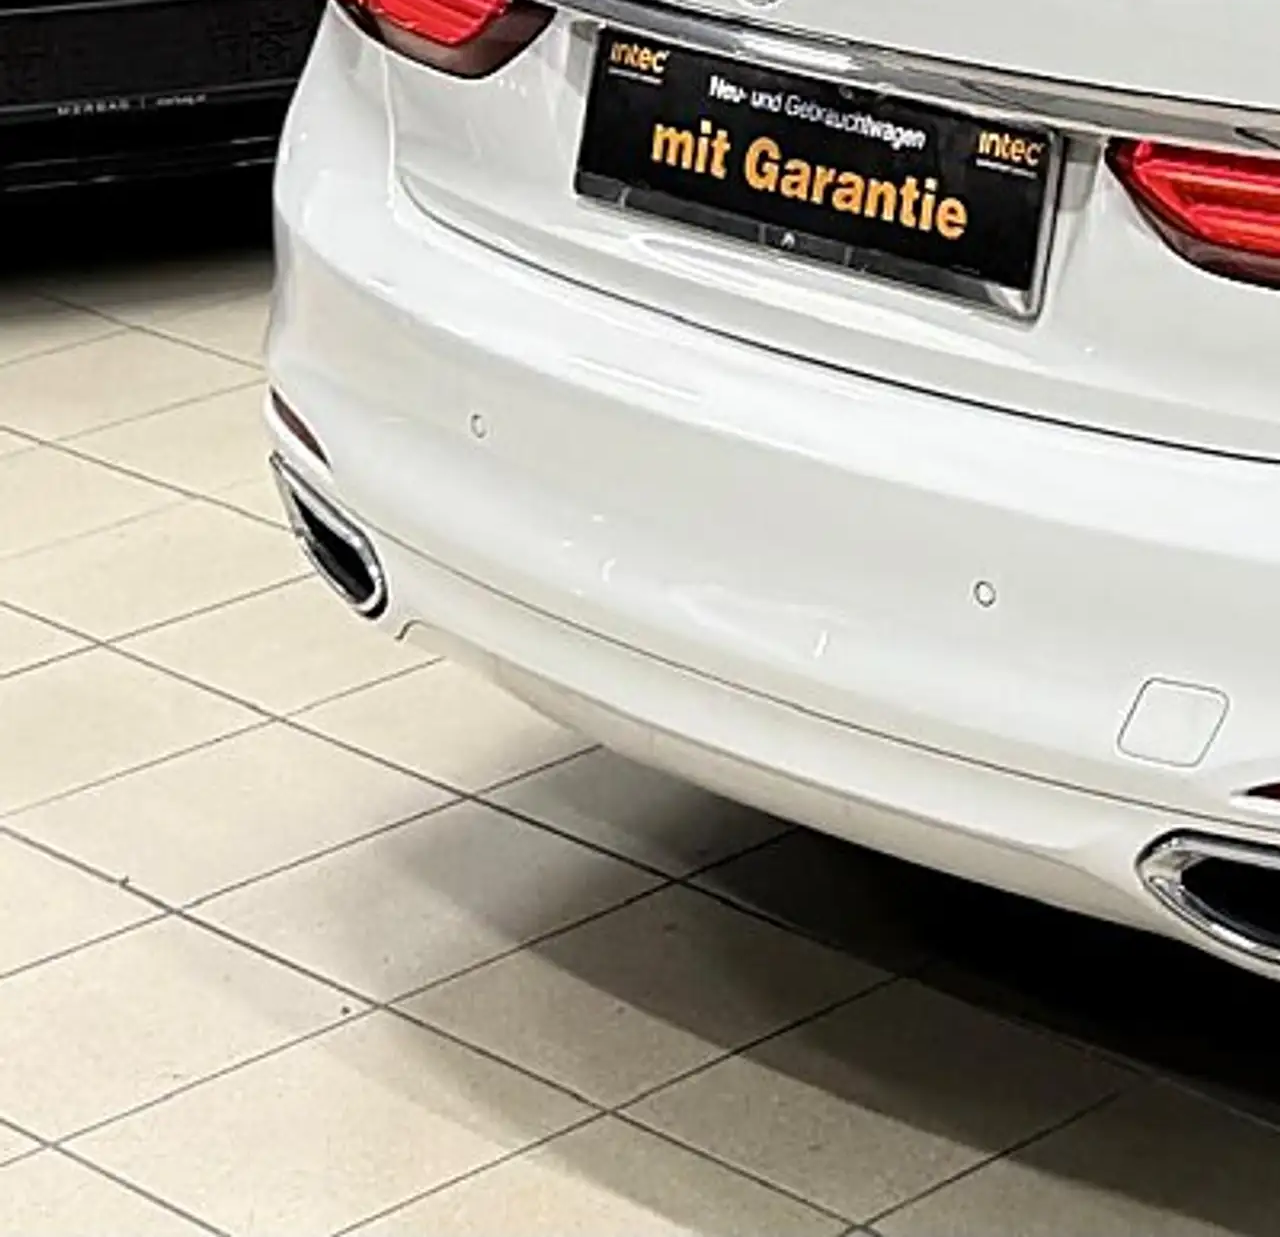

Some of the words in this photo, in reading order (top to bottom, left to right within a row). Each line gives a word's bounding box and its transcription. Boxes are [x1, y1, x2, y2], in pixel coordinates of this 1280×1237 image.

[709, 75, 748, 103] Neu-
[751, 90, 783, 112] und
[784, 95, 926, 150] Gebrauchtwagen
[652, 119, 731, 179] mit
[745, 136, 968, 240] Garantie
